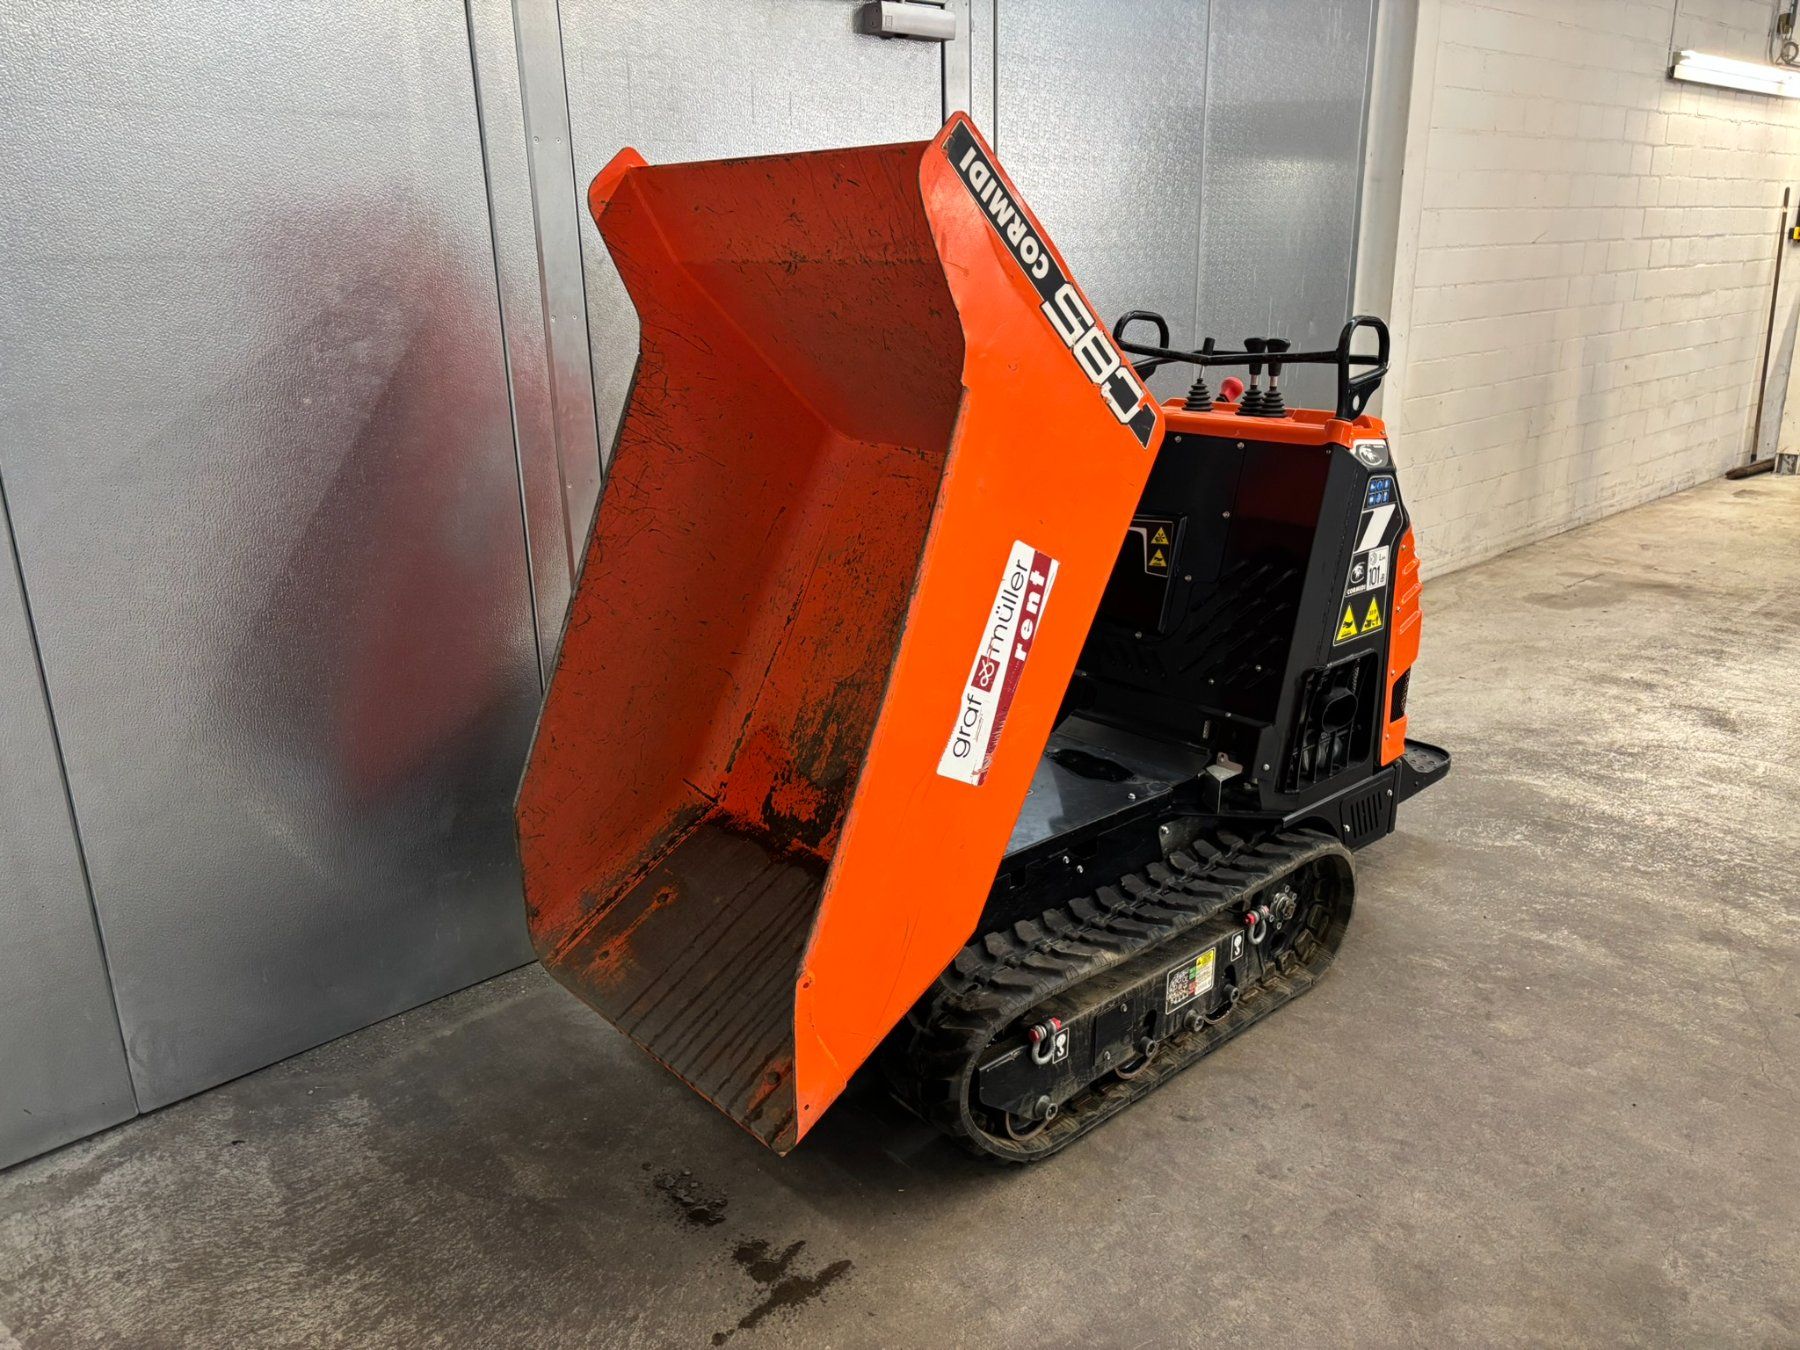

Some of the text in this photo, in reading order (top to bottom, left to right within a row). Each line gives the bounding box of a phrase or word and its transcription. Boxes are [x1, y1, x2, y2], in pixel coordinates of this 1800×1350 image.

[959, 146, 1144, 425] C85 CORMIDI
[1014, 569, 1045, 661] rent
[1369, 565, 1380, 586] 101
[953, 693, 982, 758] graf
[987, 558, 1028, 660] müller
